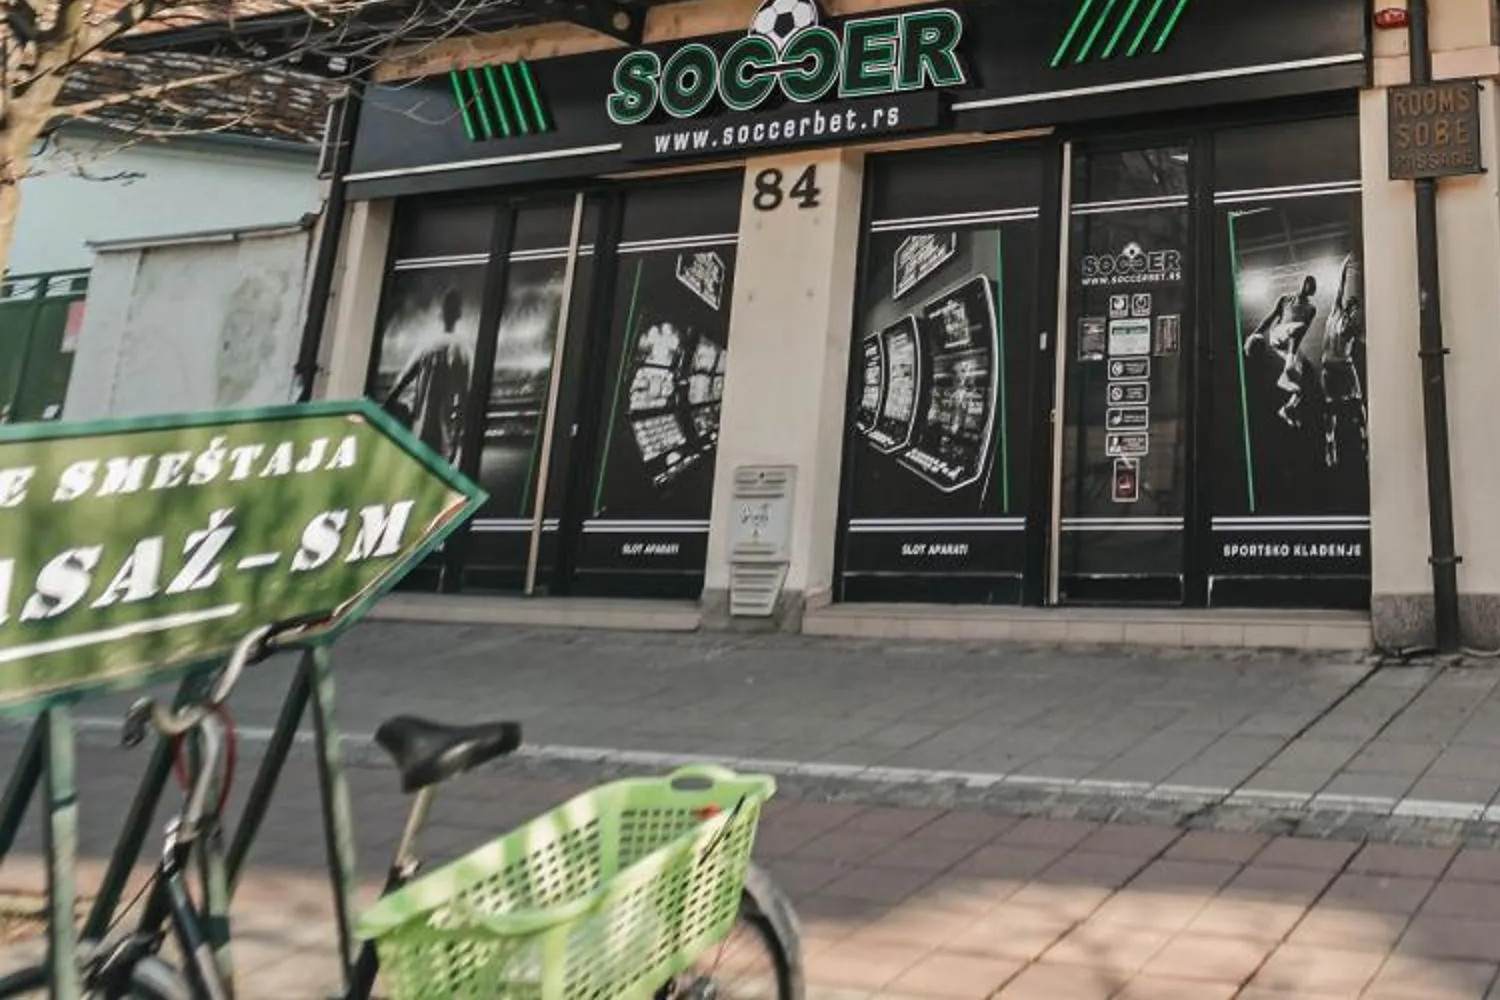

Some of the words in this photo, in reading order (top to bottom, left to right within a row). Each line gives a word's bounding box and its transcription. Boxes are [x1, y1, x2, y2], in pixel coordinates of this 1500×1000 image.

[606, 8, 965, 124] SOCCER
[1393, 88, 1471, 116] ROOMS
[654, 103, 901, 153] www.soccerbet.rs
[1395, 119, 1469, 148] SOBE
[753, 164, 821, 212] 84
[1082, 250, 1181, 276] SOCCER
[0, 500, 415, 626] SAŽ-SM
[622, 543, 643, 555] SLOT
[902, 543, 926, 555] SLOT
